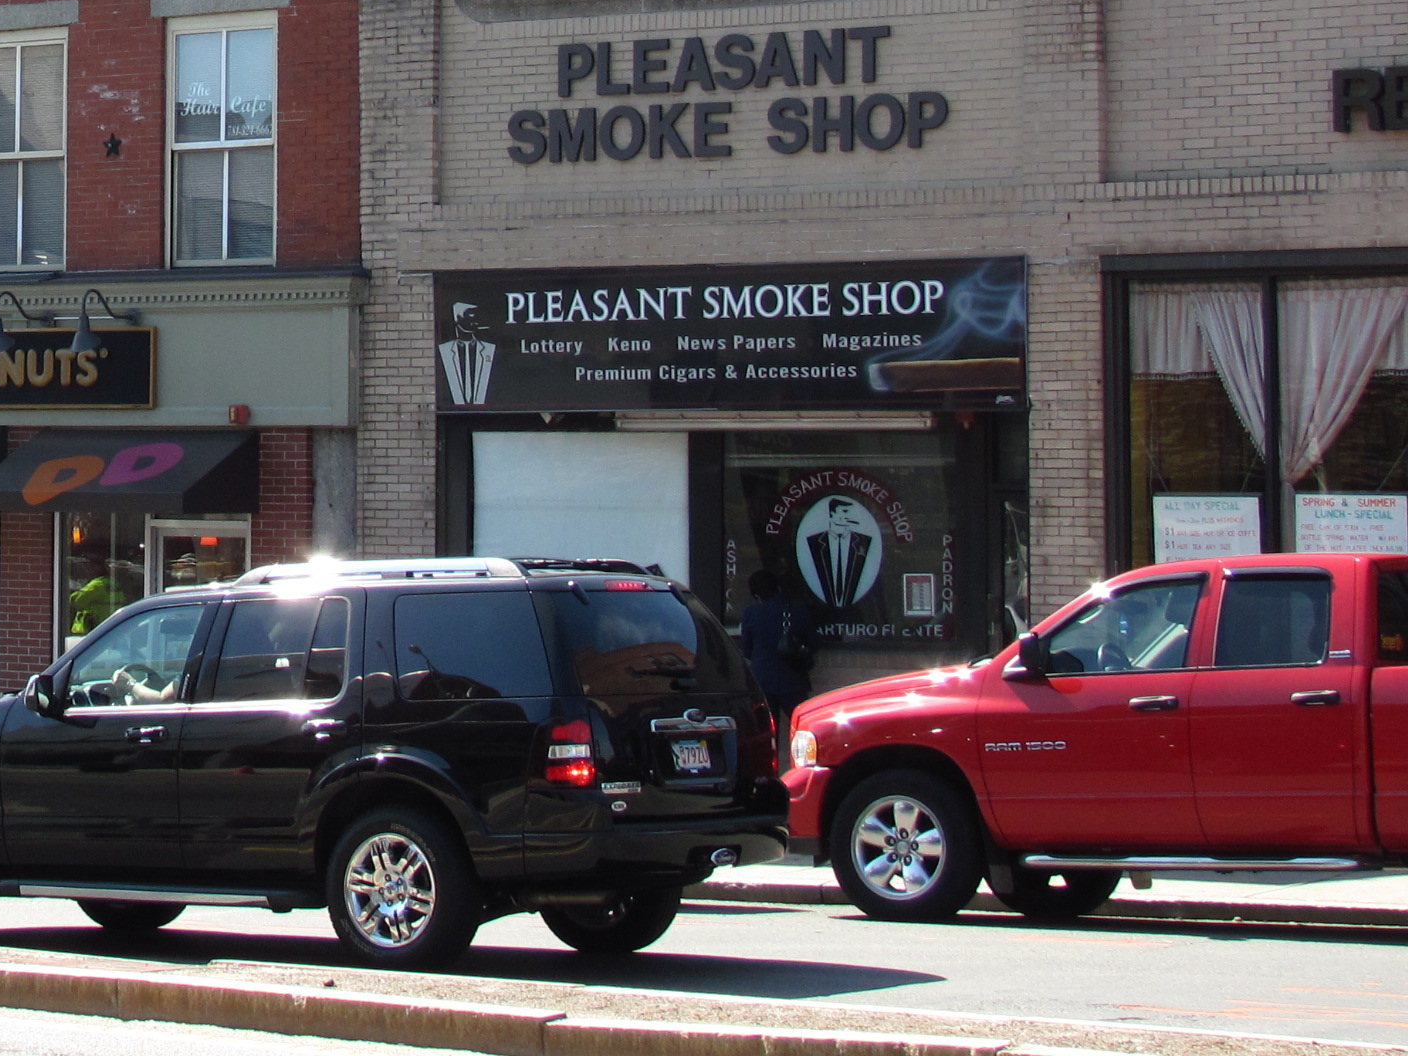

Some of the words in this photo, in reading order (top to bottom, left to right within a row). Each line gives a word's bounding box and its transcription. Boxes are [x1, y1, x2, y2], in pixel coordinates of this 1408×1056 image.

[557, 25, 891, 98] PLEASANT
[188, 82, 211, 97] The
[180, 98, 220, 117] Hair
[507, 102, 733, 165] SMOKE
[766, 91, 950, 155] SHOP
[504, 285, 693, 325] PLEASANT
[702, 281, 832, 320] SMOKE
[841, 279, 945, 316] SHOP
[520, 338, 584, 356] Lottery
[607, 336, 652, 352] Keno
[677, 334, 727, 351] News
[733, 334, 796, 353] Papers
[822, 332, 923, 351] Magazines
[574, 365, 653, 382] Premium
[658, 364, 717, 383] Cigars
[724, 364, 739, 380] &
[745, 362, 858, 380] Accessories
[766, 471, 834, 535] PLEASANT
[837, 471, 889, 505] SMOKE
[886, 501, 914, 543] SHOP
[1204, 500, 1240, 511] SPECIAL
[1302, 497, 1335, 507] SPRING
[1341, 497, 1348, 507] &
[1357, 497, 1397, 507] SUMMER
[1314, 509, 1346, 519] LUNCH
[1355, 509, 1394, 520] SPECIAL
[1164, 527, 1175, 537] $1
[1164, 540, 1175, 550] $1
[942, 534, 954, 614] PADRON
[816, 623, 878, 637] ARTURO
[985, 742, 1022, 752] RAM
[1025, 741, 1066, 750] 1500
